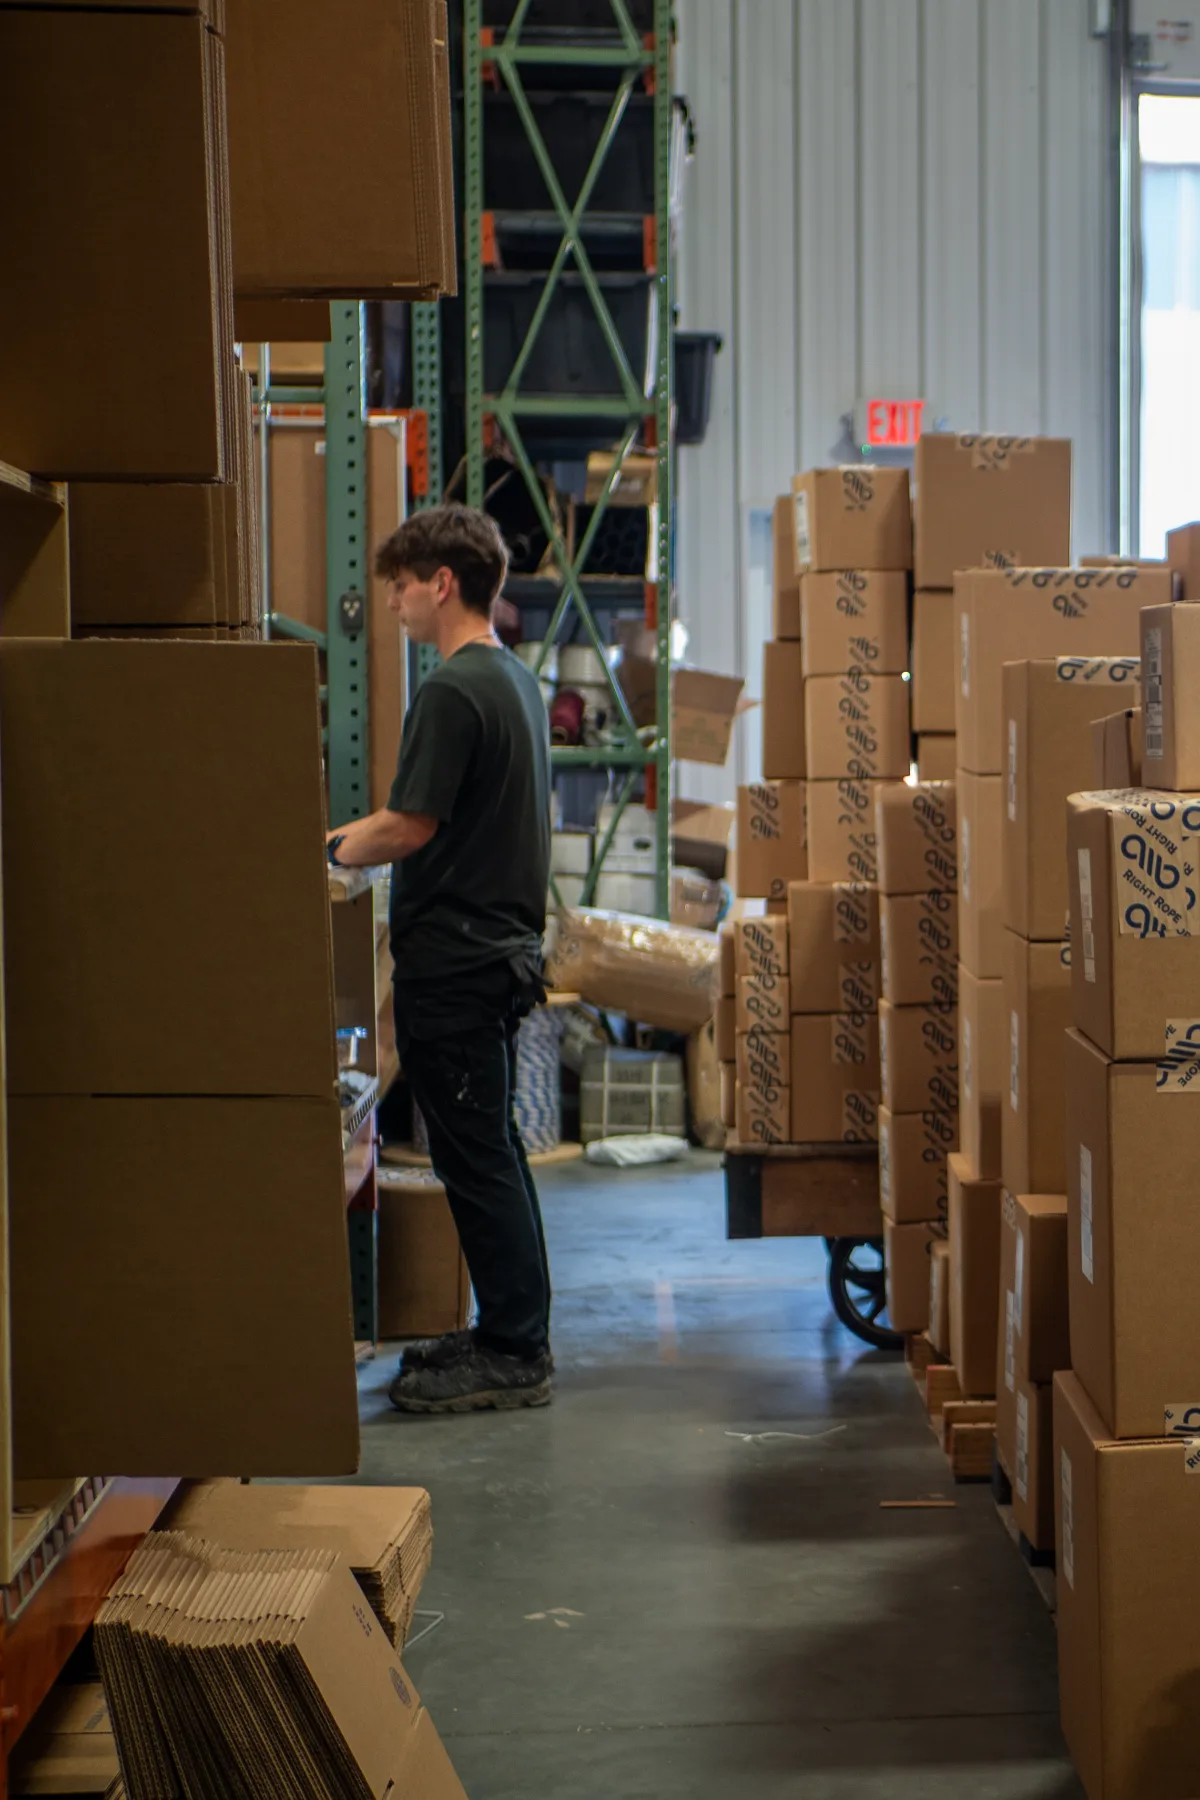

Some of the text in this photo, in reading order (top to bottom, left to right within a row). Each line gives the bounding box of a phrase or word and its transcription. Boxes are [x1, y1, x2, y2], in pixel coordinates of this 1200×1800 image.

[867, 400, 924, 445] EXIT
[1145, 824, 1178, 855] RIGHT
[1122, 868, 1155, 899] RIGHT
[1154, 895, 1182, 924] ROPE
